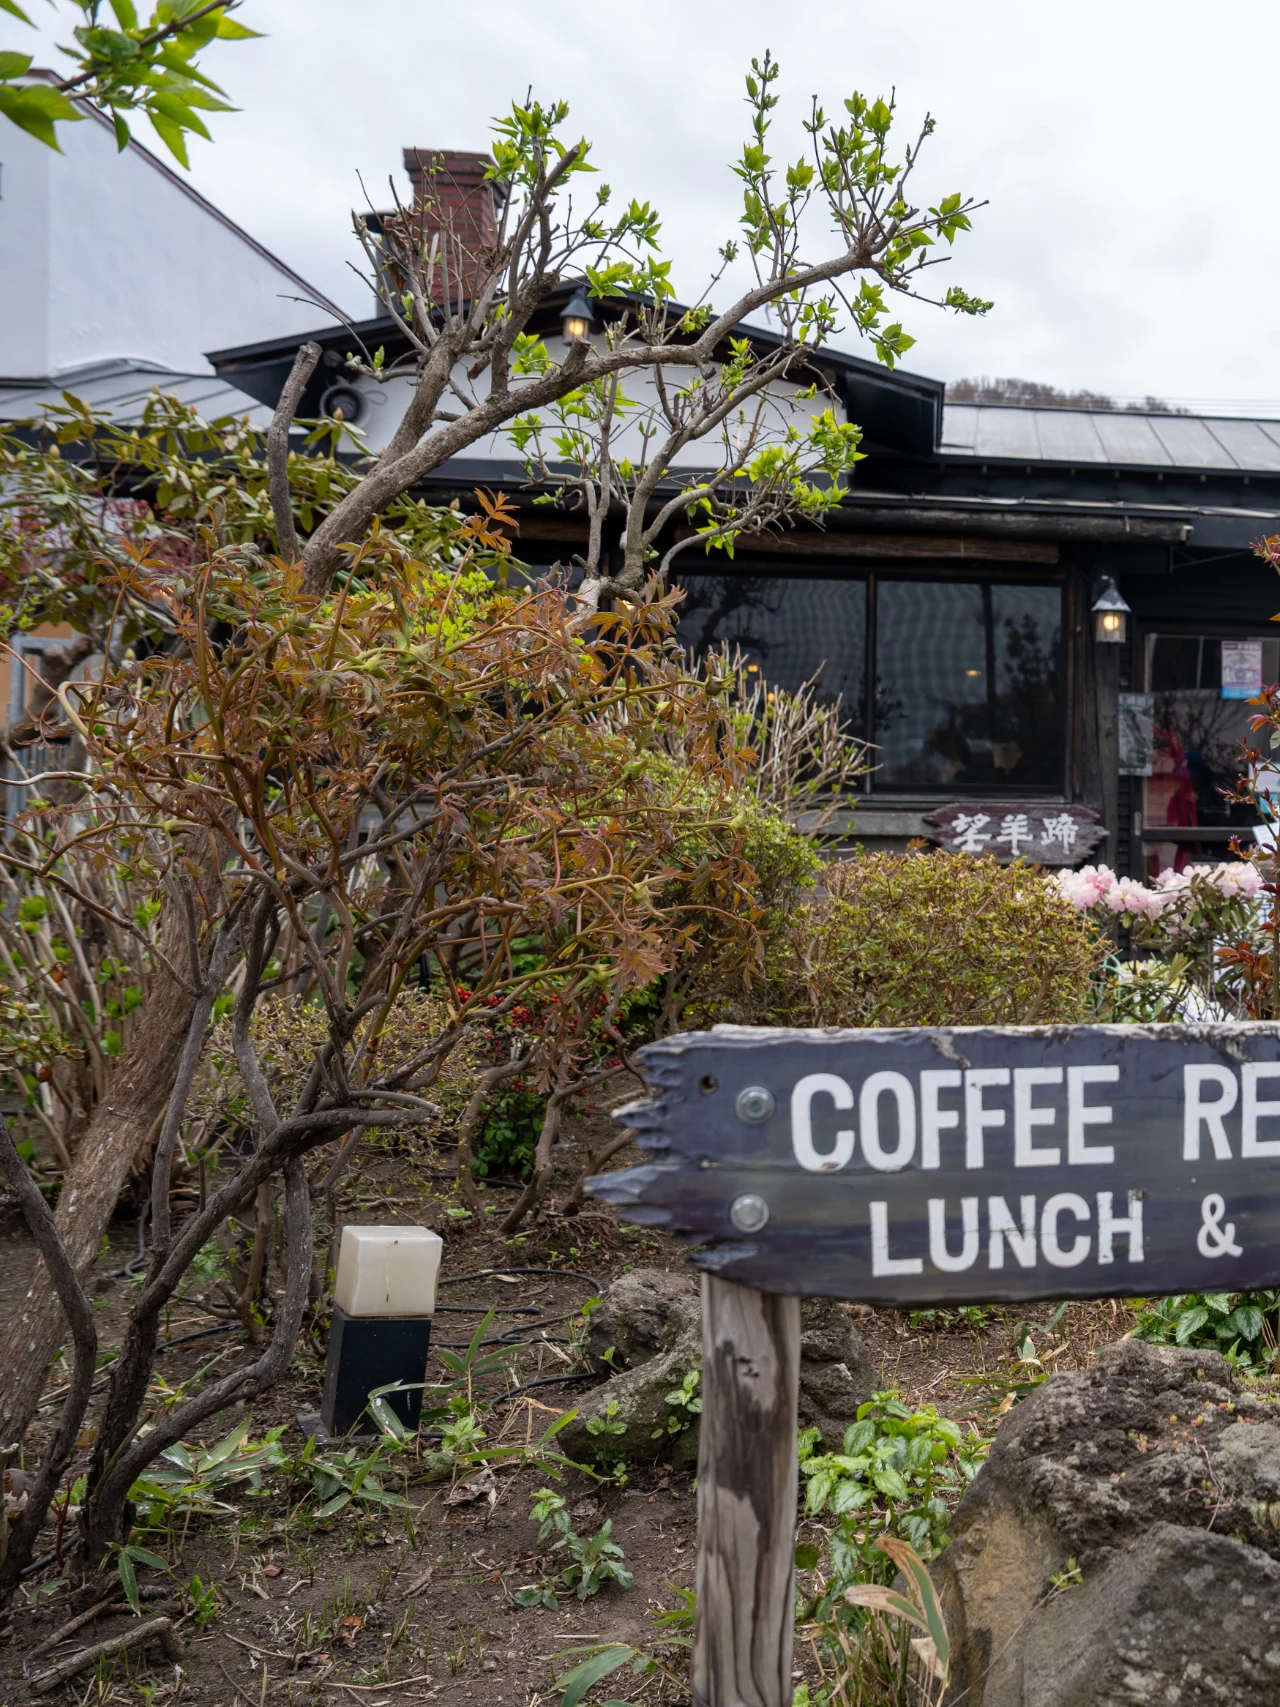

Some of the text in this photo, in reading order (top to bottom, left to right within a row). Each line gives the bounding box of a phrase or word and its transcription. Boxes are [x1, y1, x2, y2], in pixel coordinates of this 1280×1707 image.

[951, 813, 1080, 856] 望羊蹄
[790, 1064, 1120, 1173] COFFEE
[869, 1189, 1145, 1277] LUNCH
[1197, 1193, 1243, 1258] &
